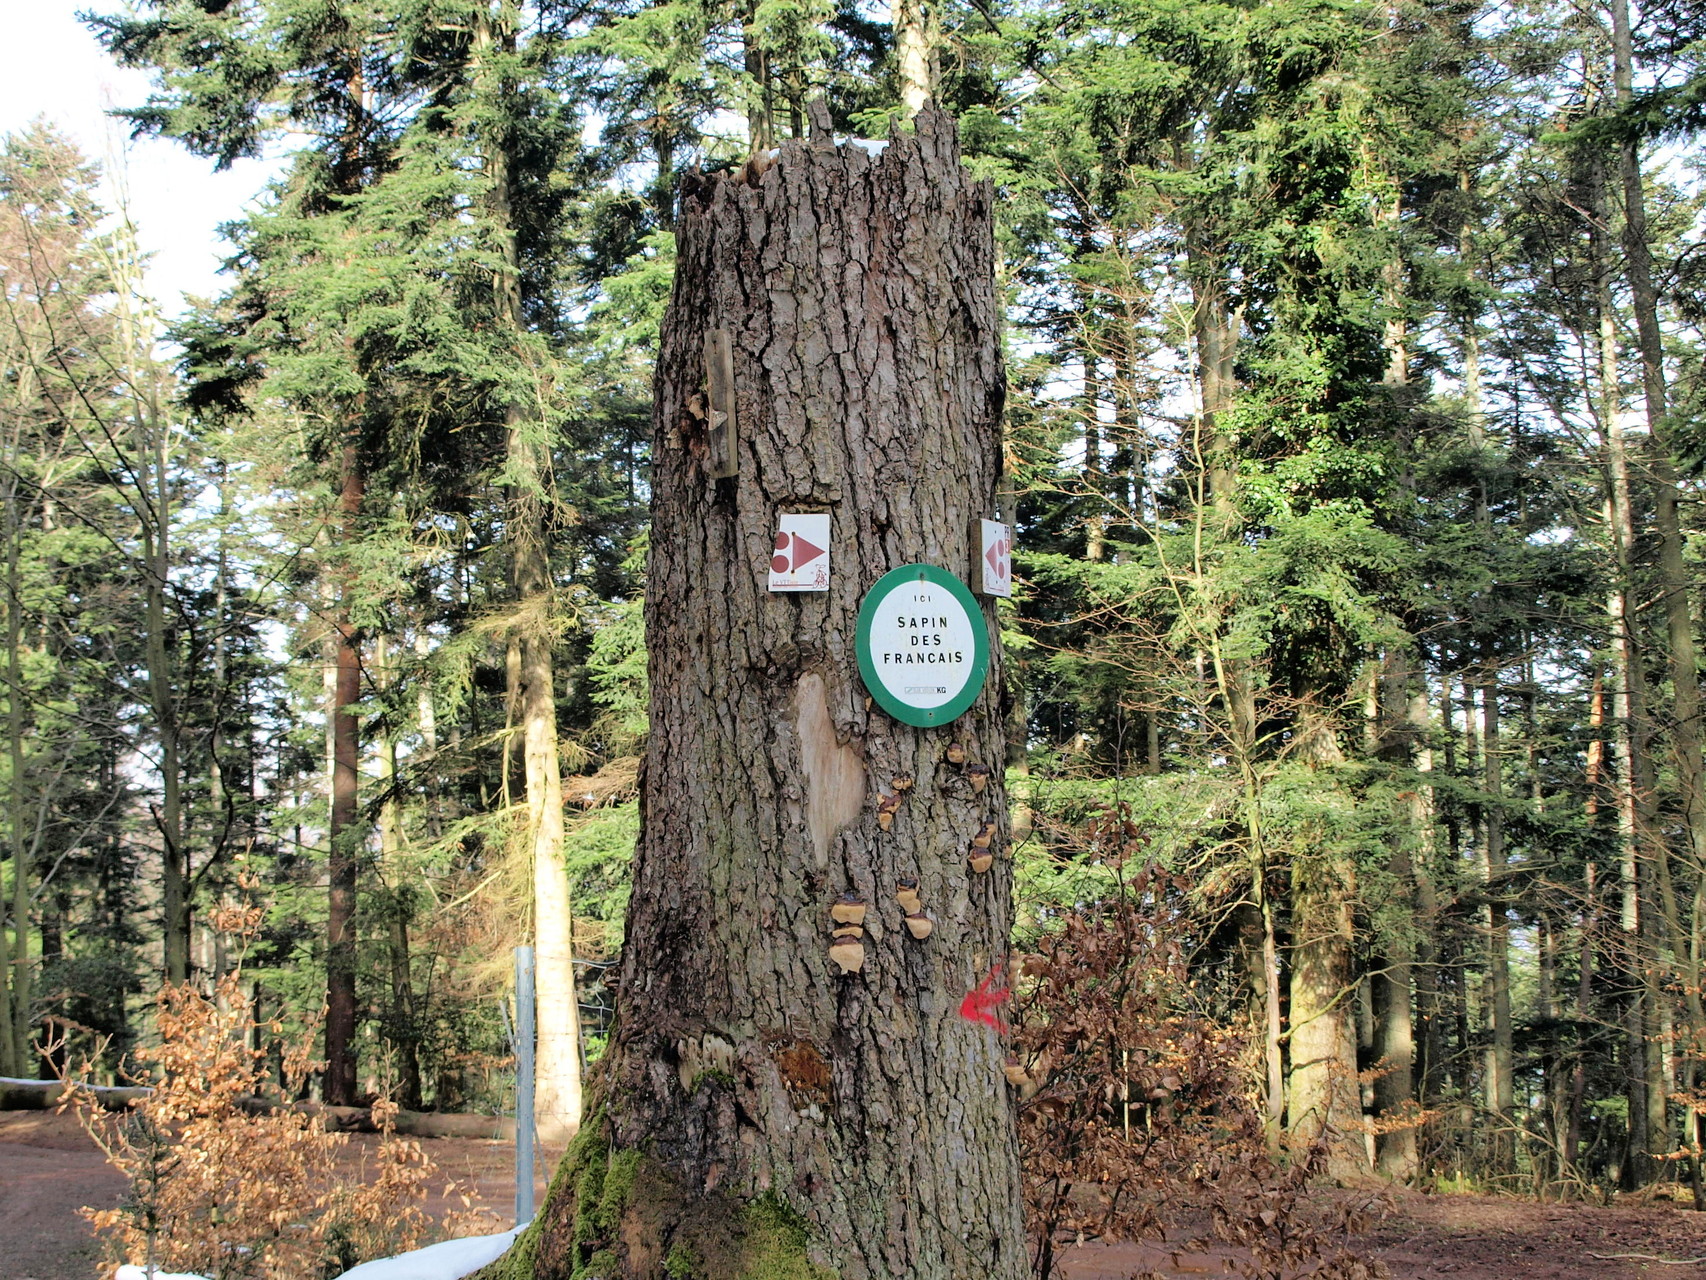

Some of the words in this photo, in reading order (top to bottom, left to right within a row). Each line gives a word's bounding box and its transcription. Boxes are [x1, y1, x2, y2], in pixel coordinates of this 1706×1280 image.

[914, 595, 931, 603] ICI
[897, 616, 948, 628] SAPIN
[911, 634, 941, 646] DES
[884, 651, 963, 664] FRANCAIS
[936, 686, 947, 694] KG
